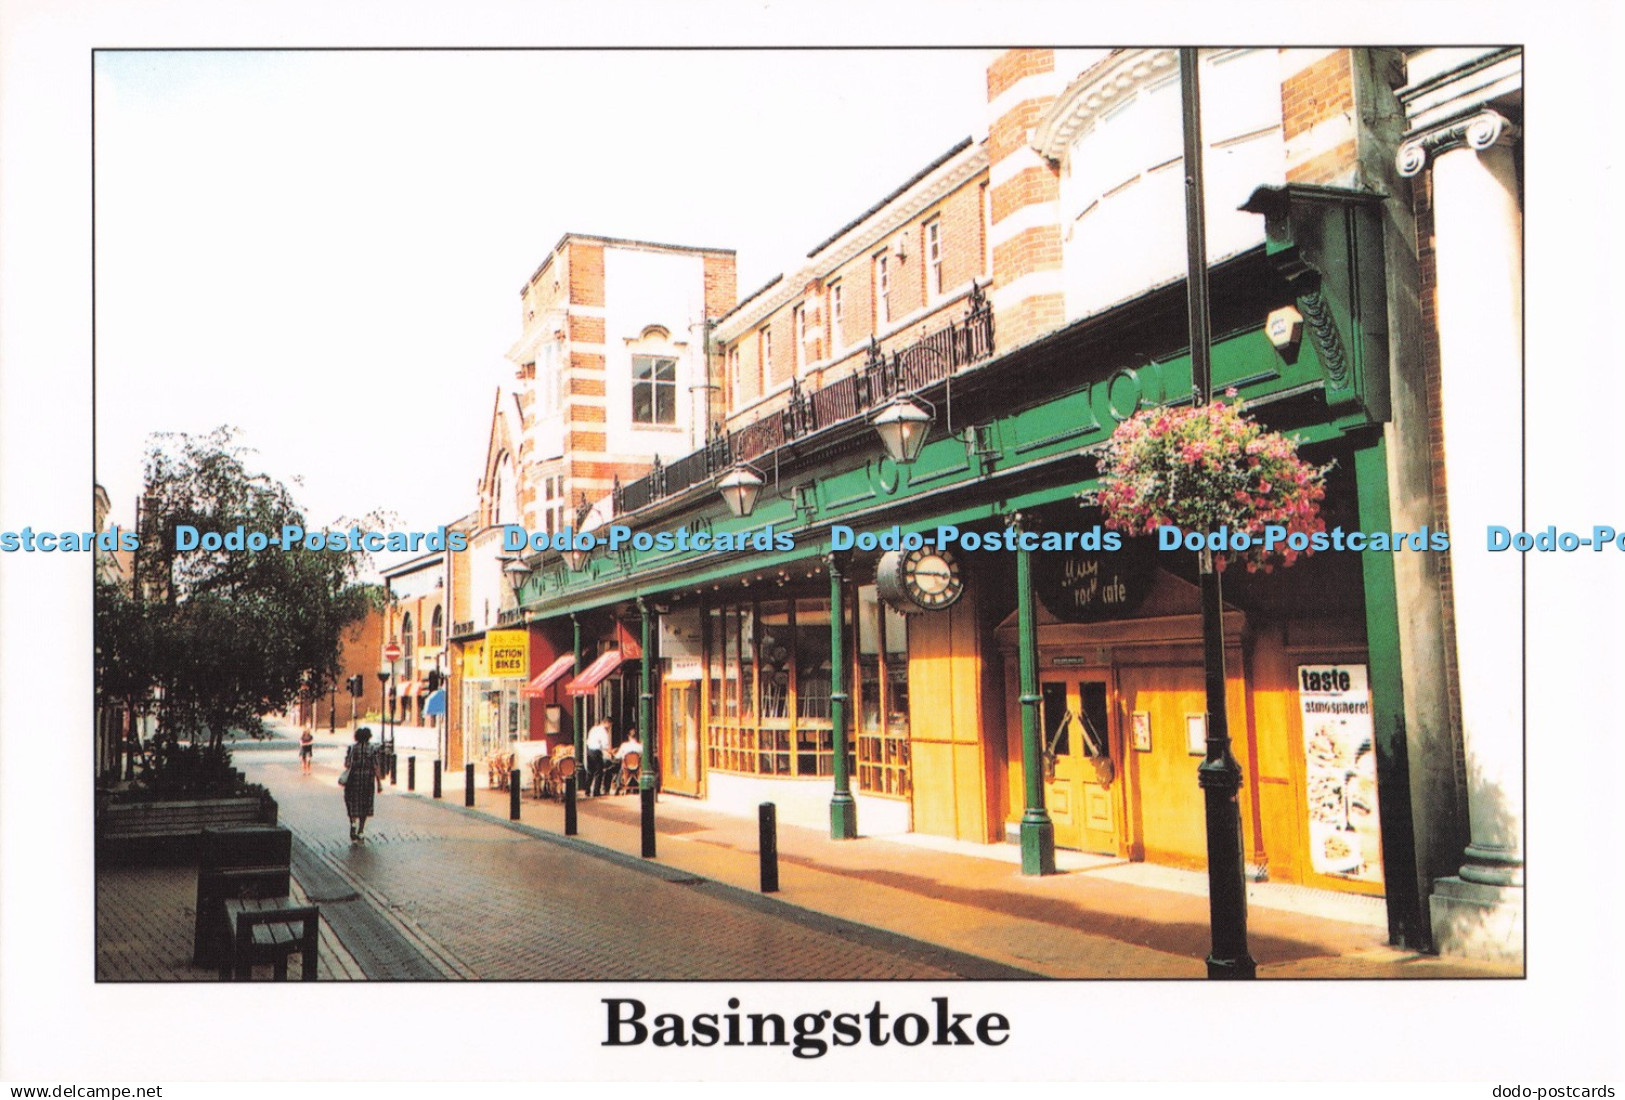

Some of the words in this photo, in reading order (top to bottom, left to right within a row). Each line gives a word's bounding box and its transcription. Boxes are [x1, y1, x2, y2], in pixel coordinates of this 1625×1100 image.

[1102, 575, 1127, 605] cafe
[494, 648, 522, 659] ACTION
[496, 659, 521, 669] BIKES
[1301, 668, 1351, 692] taste
